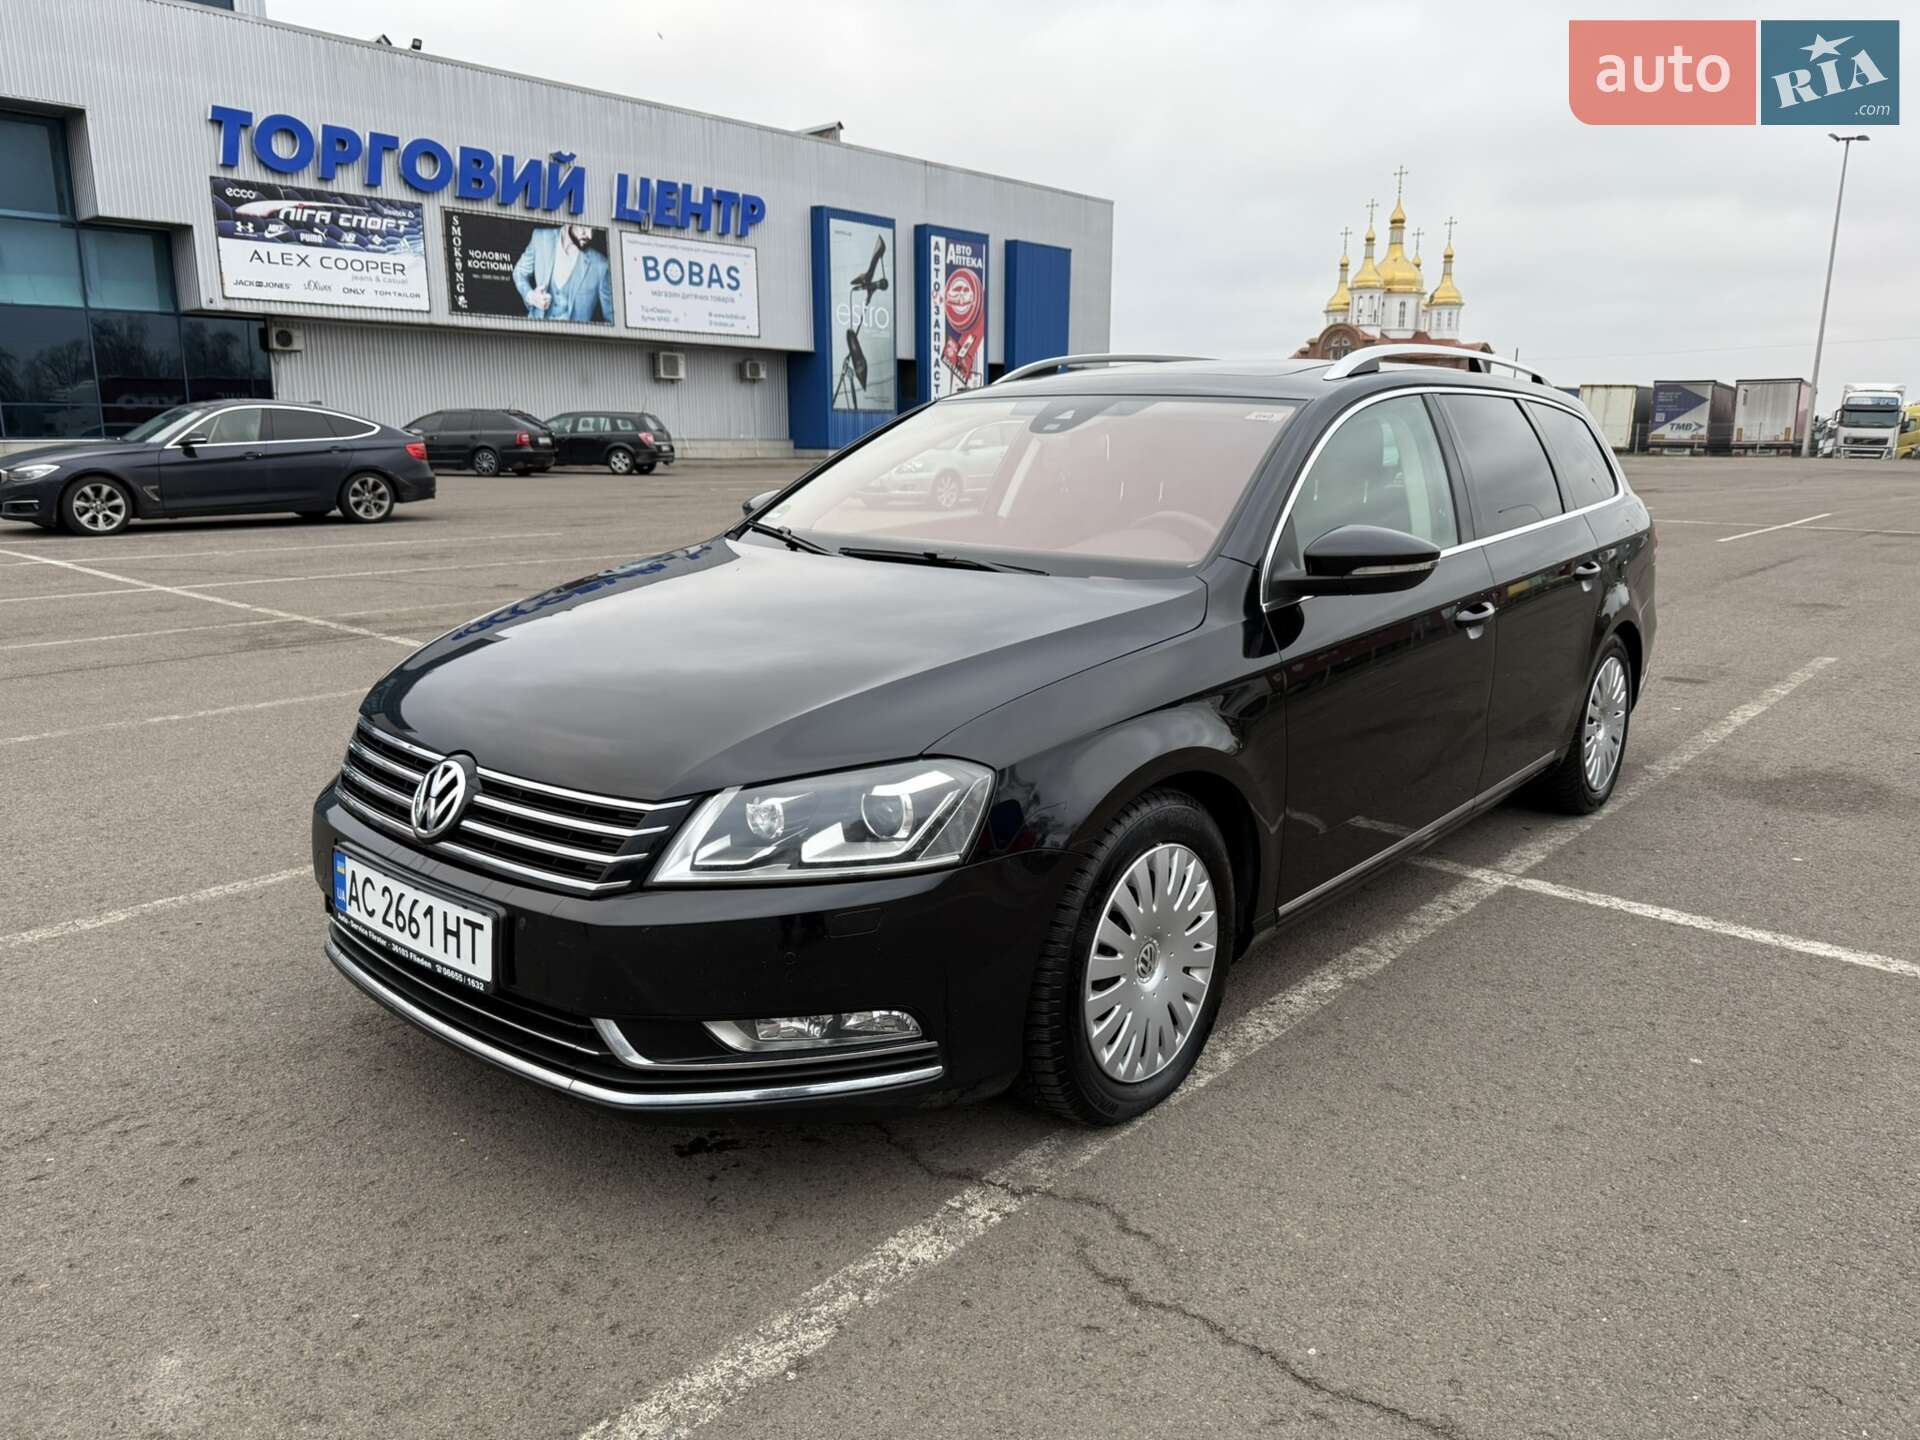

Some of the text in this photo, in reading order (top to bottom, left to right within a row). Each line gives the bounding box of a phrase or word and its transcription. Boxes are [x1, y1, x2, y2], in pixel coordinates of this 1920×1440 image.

[208, 105, 766, 238] ТОРГОВИЙ ЦЕНТР
[225, 187, 256, 199] ecco
[249, 249, 406, 276] ALEX COOPER
[468, 248, 511, 262] ЧОЛОВІЧІ
[467, 260, 514, 273] КОСТЮМИ
[642, 255, 741, 291] BOBAS
[342, 286, 366, 295] ONLY
[836, 303, 890, 329] estro
[337, 887, 346, 901] UA
[348, 869, 484, 965] AC 2661 HT
